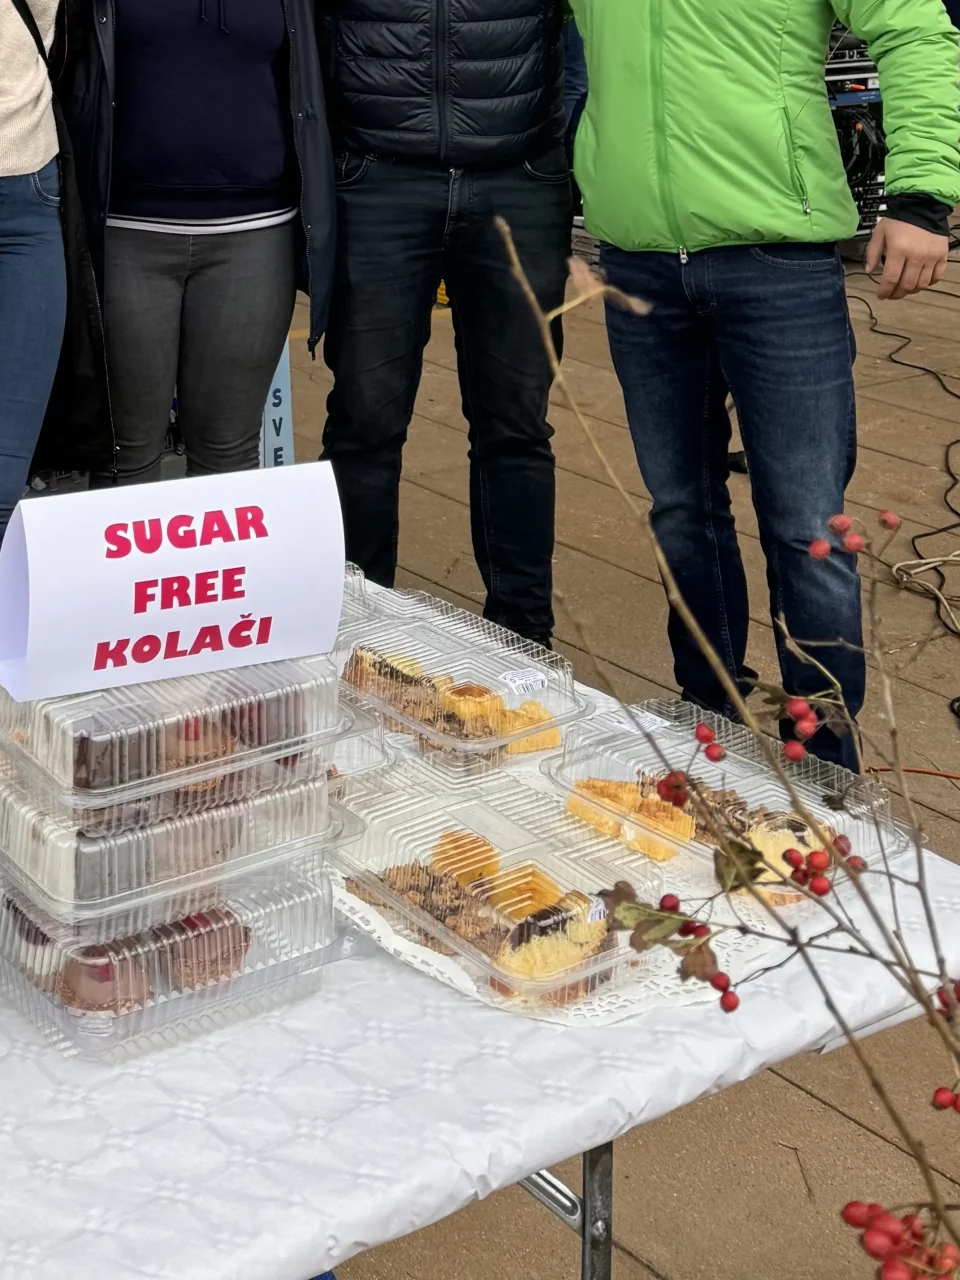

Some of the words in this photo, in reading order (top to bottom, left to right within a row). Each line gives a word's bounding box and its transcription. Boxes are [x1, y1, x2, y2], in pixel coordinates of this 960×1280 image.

[104, 505, 269, 559] SUGAR
[133, 566, 246, 615] FREE
[93, 613, 273, 671] KOLAČI
